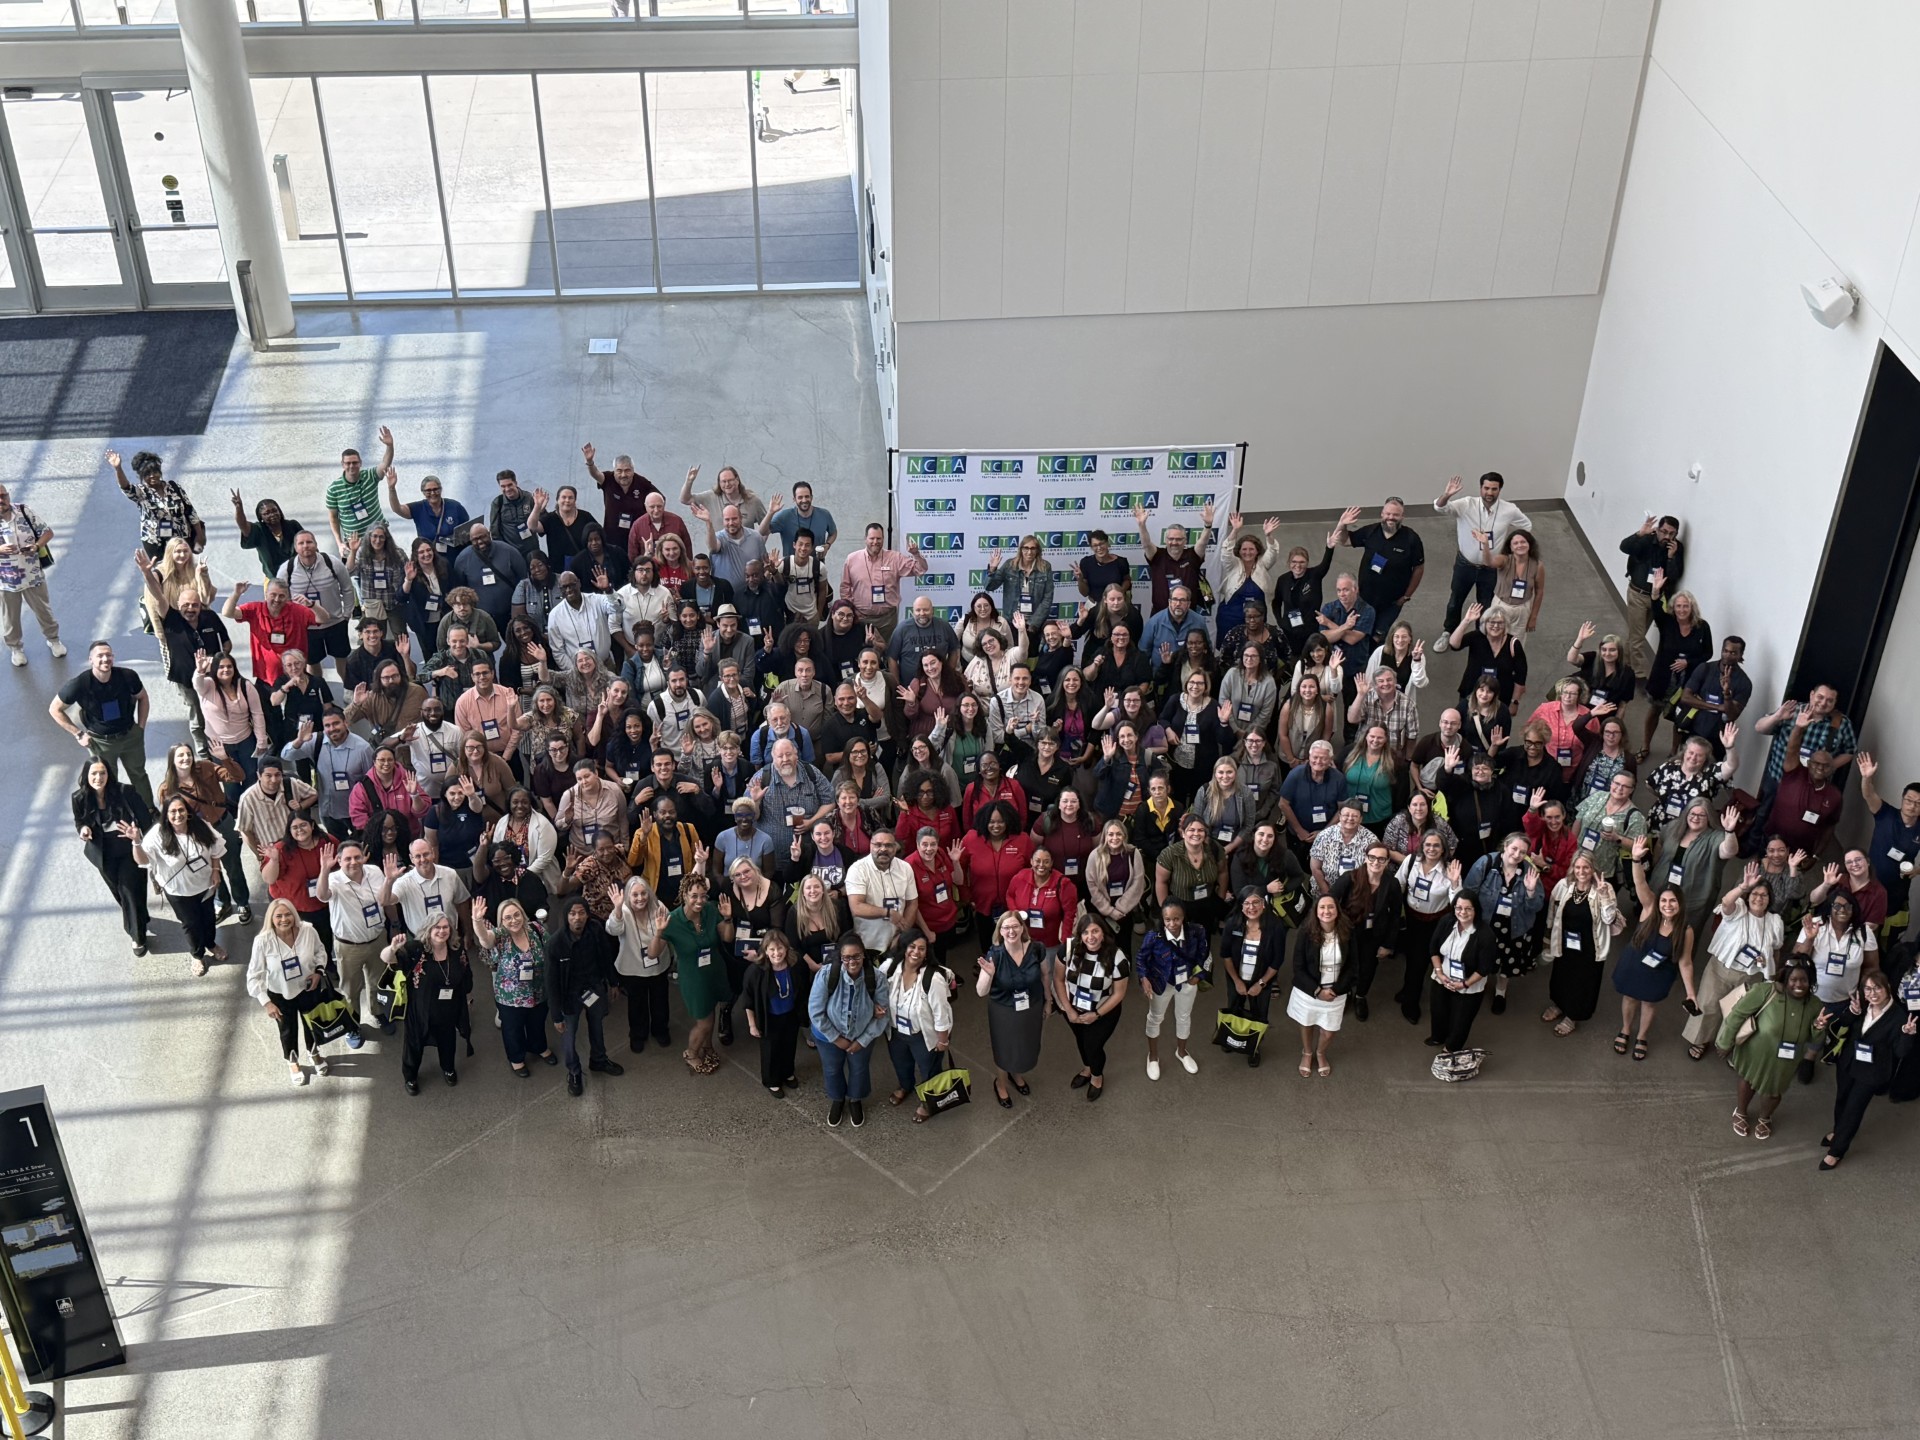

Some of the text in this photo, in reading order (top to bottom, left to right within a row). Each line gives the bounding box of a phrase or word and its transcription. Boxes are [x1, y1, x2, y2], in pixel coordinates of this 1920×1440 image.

[909, 458, 965, 473] NCTA
[982, 462, 1022, 472] NCTA
[1039, 458, 1096, 472] NCTA
[1112, 459, 1152, 470] NCTA
[1169, 454, 1225, 469] NCTA
[916, 500, 955, 510] NCTA
[973, 497, 1028, 510] NCTA
[1045, 499, 1085, 509] NCTA
[1102, 494, 1157, 508] NCTA
[980, 537, 1018, 547] NCTA
[1036, 533, 1090, 547] NCTA
[670, 577, 686, 585] STA
[916, 575, 954, 585] NCTA
[19, 1116, 38, 1148] 1
